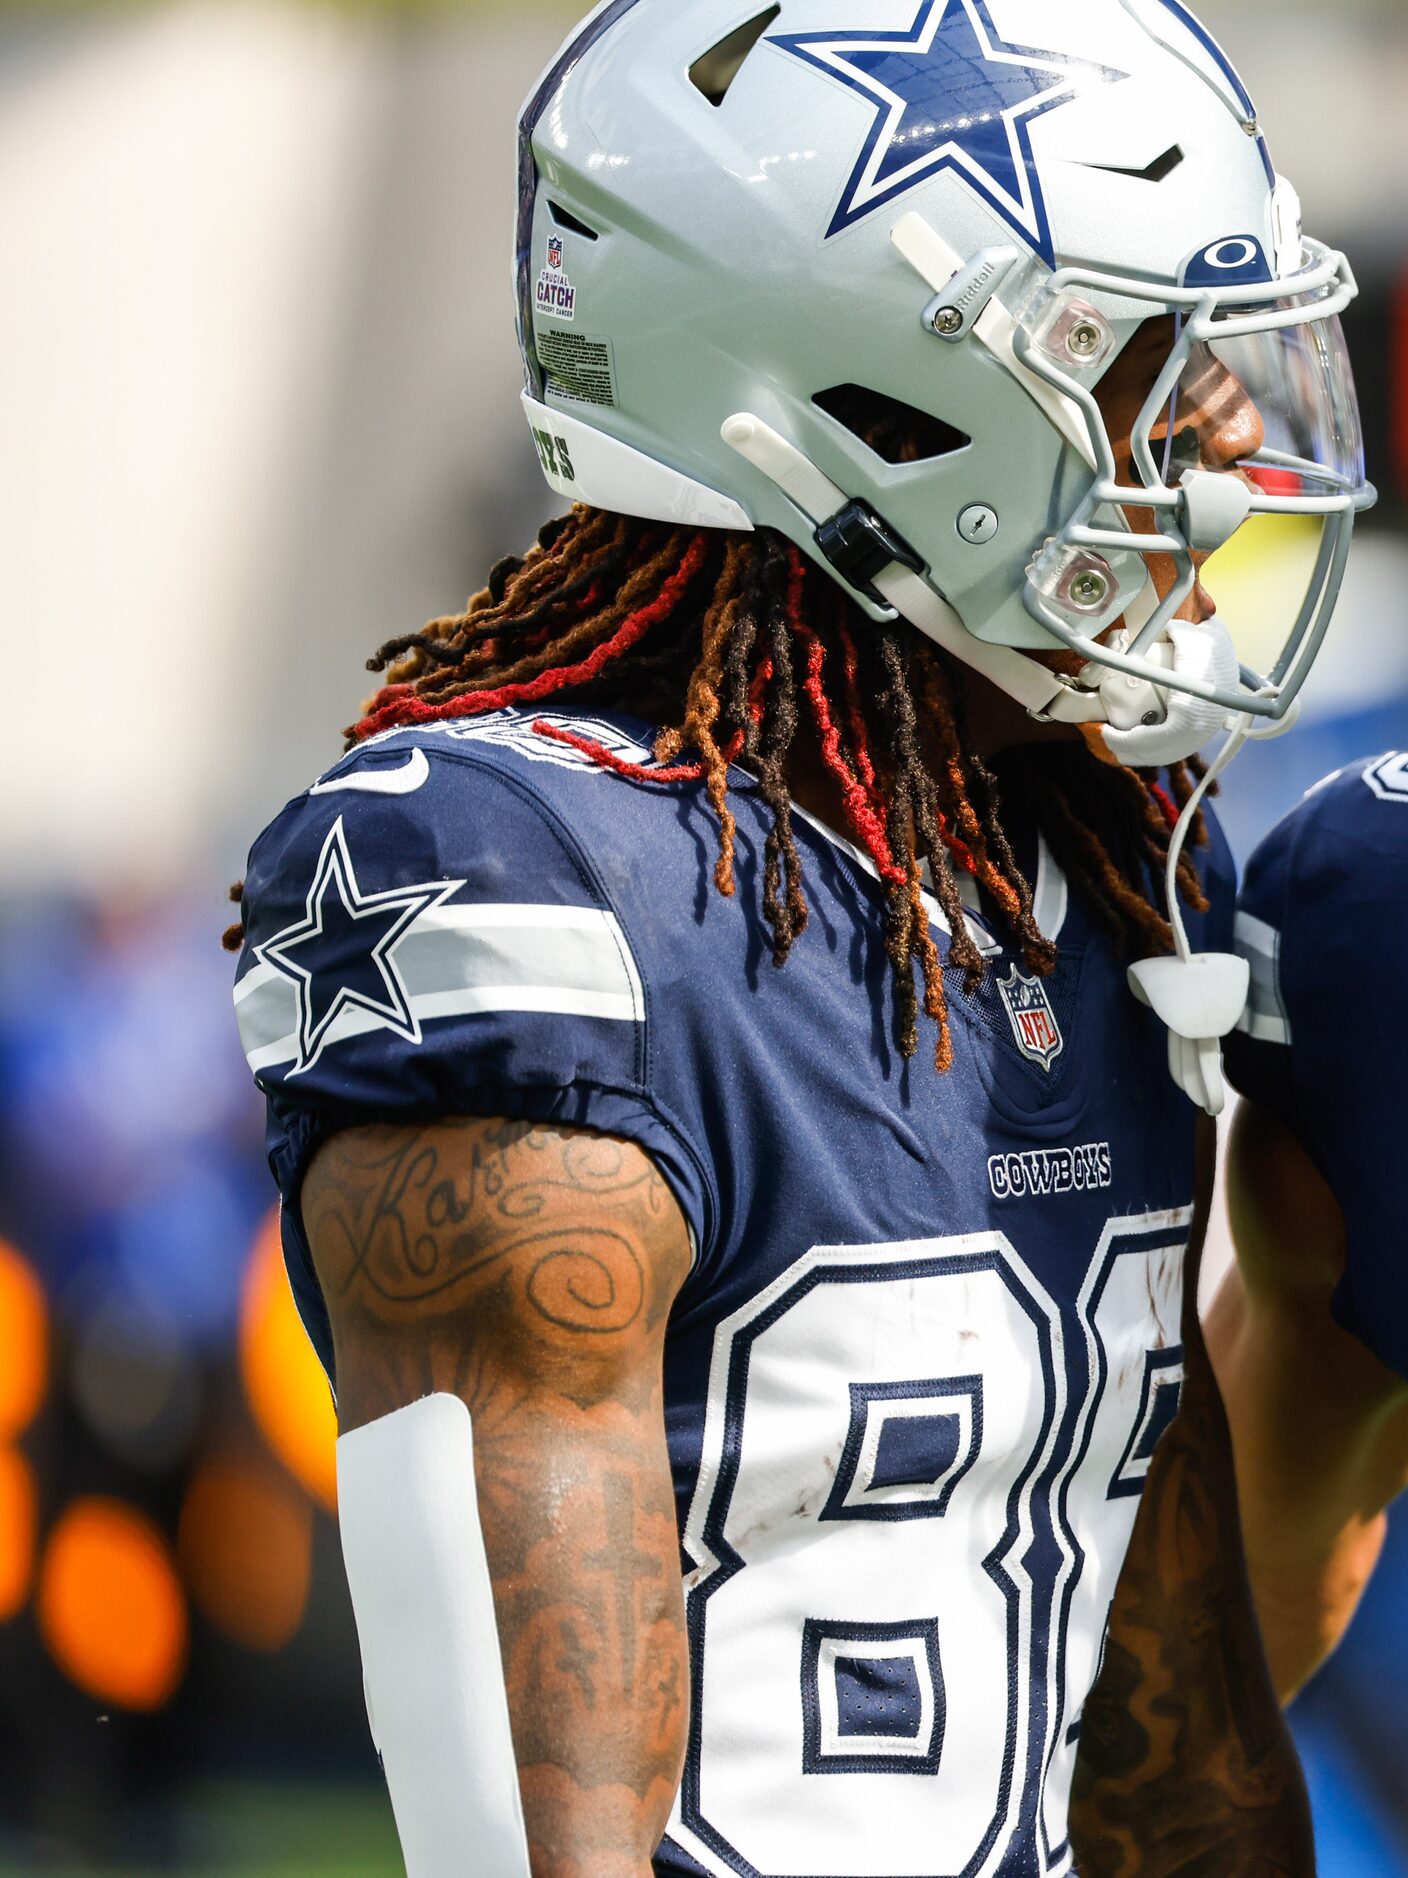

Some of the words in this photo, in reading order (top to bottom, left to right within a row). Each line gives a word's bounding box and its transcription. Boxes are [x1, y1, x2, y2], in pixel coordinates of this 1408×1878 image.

[547, 249, 561, 265] NFL
[541, 271, 569, 287] CRUCIAL
[953, 261, 996, 311] Riddell
[537, 281, 575, 309] CATCH
[556, 307, 573, 318] CANCER
[549, 329, 586, 342] WARNING
[1018, 1010, 1057, 1051] NFL
[987, 1142, 1112, 1199] COWBOYS
